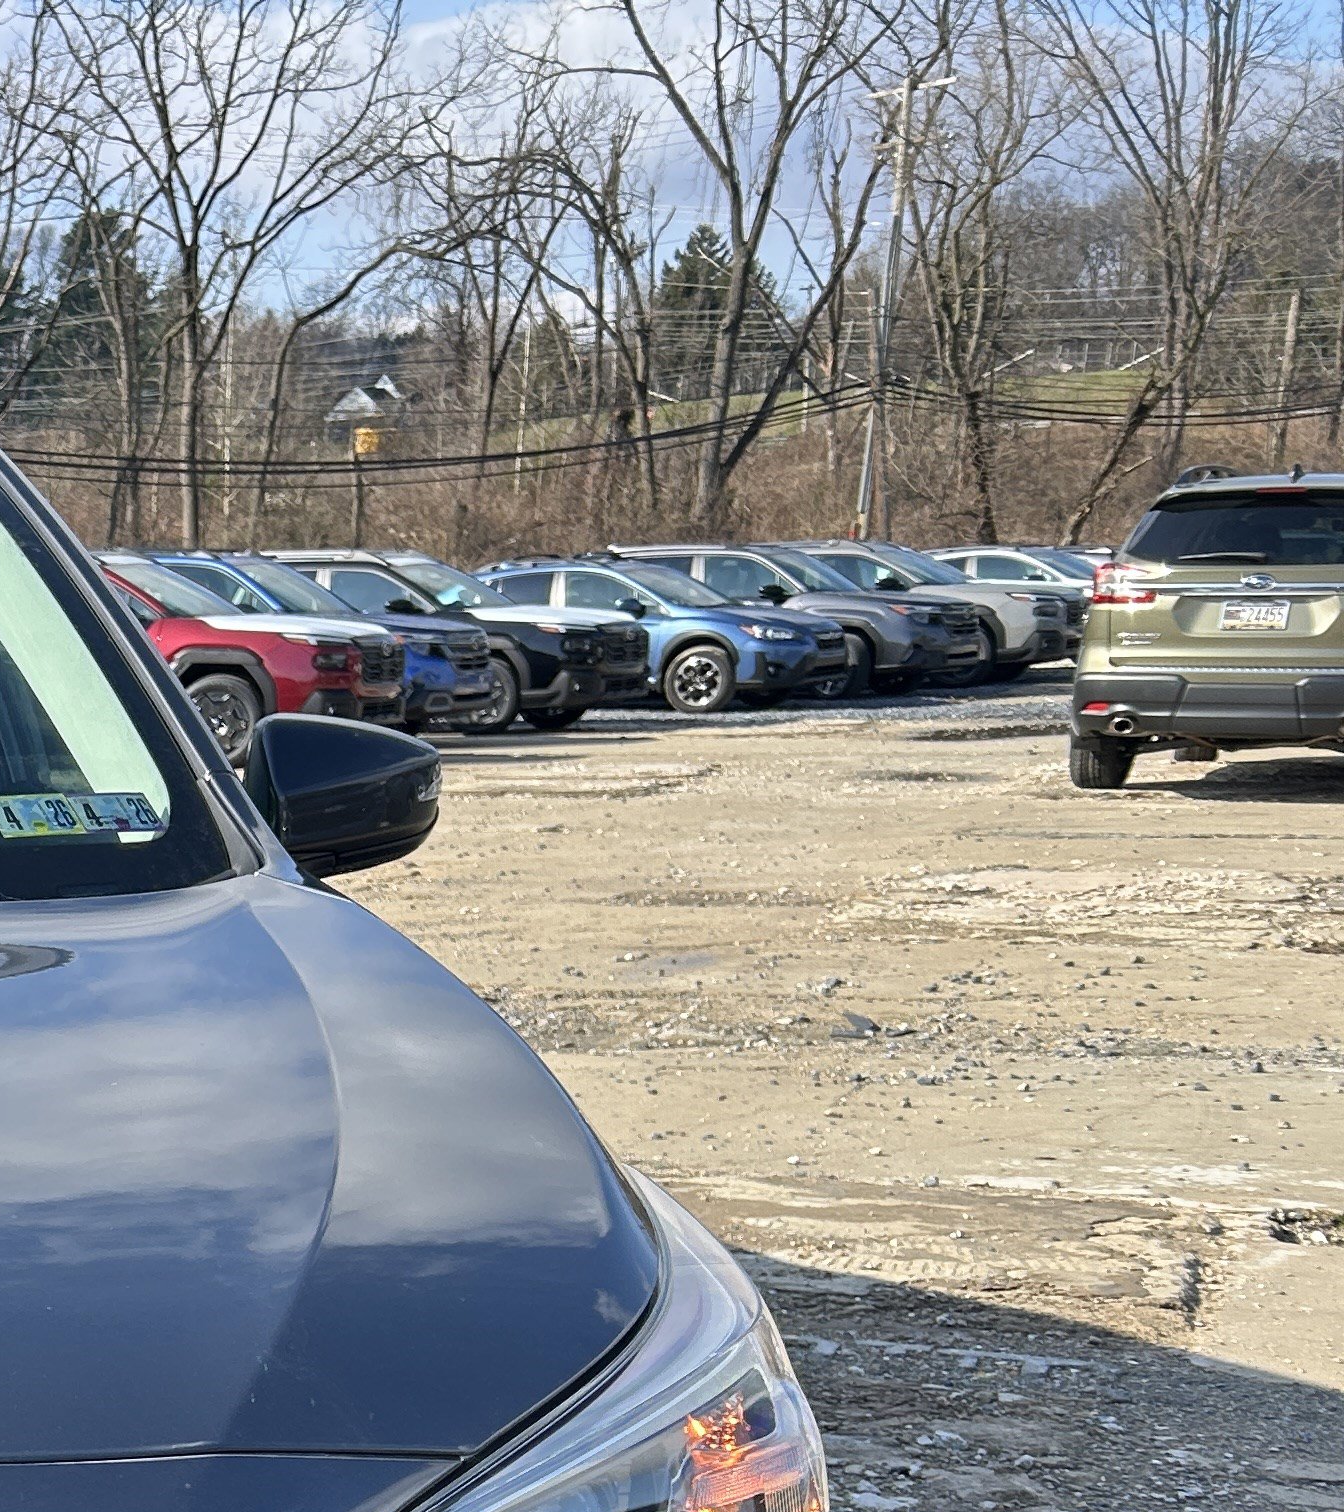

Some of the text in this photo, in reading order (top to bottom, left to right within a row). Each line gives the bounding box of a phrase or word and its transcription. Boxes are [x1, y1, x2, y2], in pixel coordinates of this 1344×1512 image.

[2, 806, 25, 831] 4
[45, 799, 77, 827] 26
[82, 803, 104, 827] 4
[126, 797, 159, 825] 26
